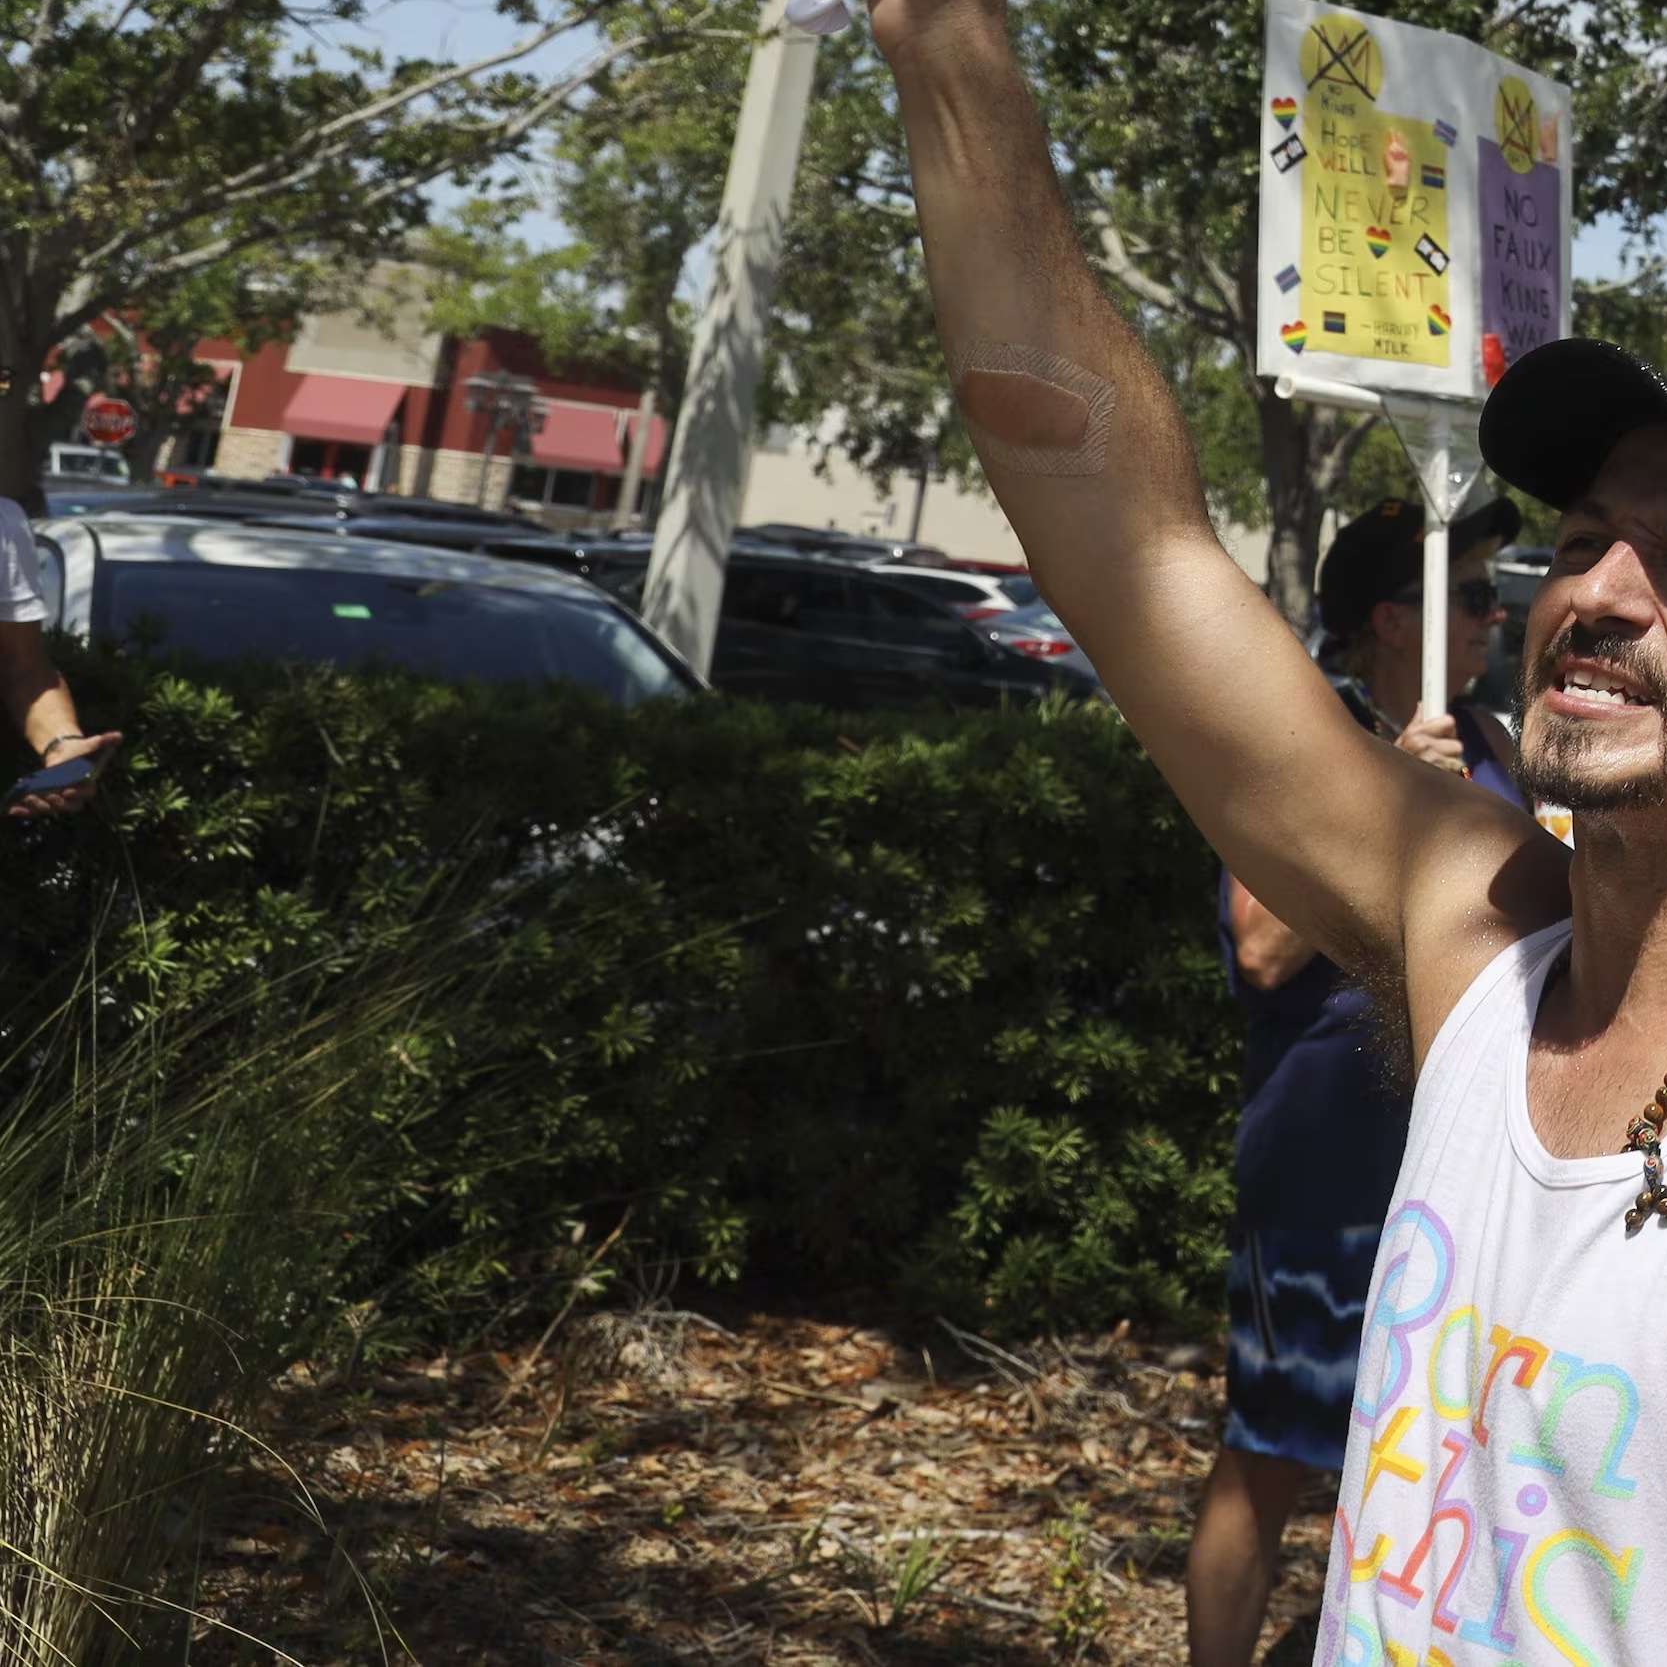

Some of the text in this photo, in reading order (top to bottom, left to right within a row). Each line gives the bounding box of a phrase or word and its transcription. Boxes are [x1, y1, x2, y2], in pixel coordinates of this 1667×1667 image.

[1316, 149, 1377, 176] WILL
[1315, 182, 1431, 226] NEVER
[1504, 186, 1537, 227] NO
[1318, 226, 1355, 256] BE
[1493, 225, 1552, 272] FAUX
[1312, 263, 1431, 303] SILENT
[1352, 1199, 1640, 1501] Born
